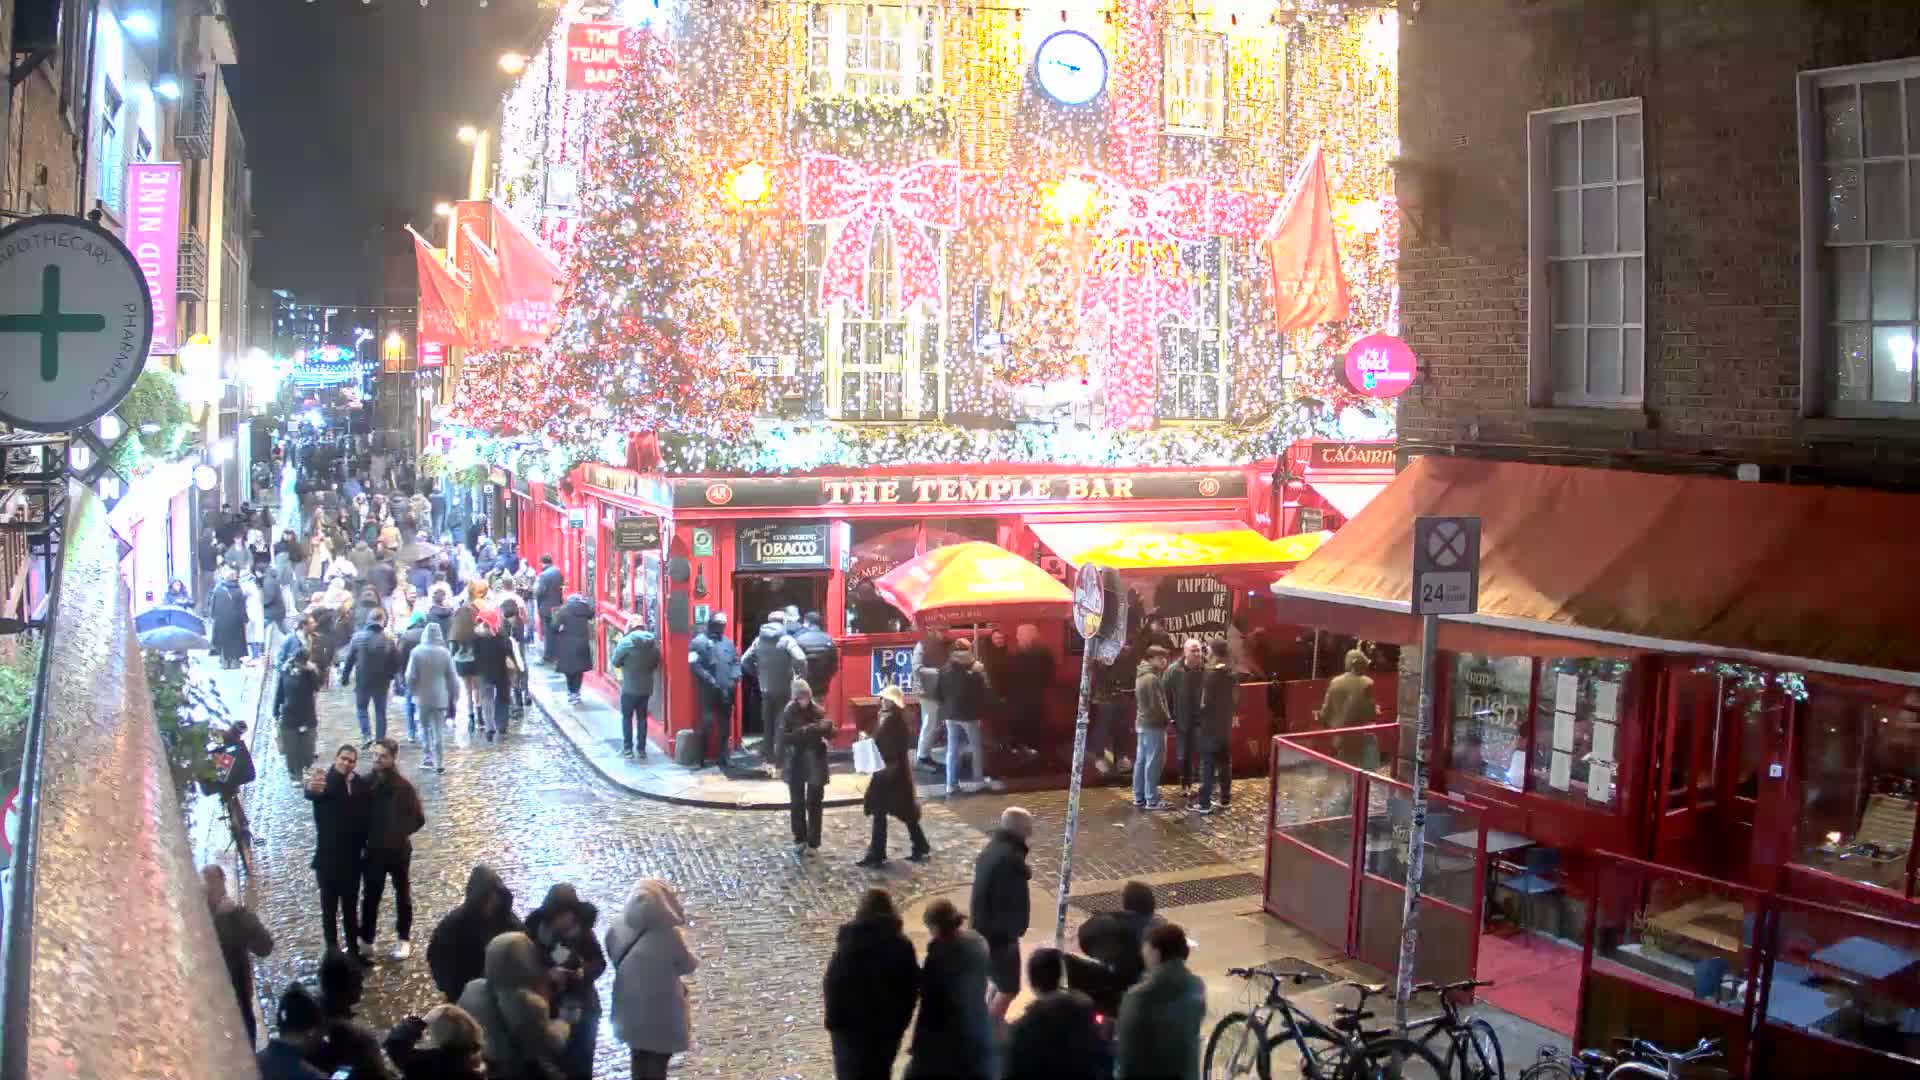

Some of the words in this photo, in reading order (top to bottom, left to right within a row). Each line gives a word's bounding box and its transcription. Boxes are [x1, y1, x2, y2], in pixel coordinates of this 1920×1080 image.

[137, 171, 170, 232] NINE
[823, 478, 900, 504] THE
[912, 476, 1051, 504] TEMPLE
[1068, 476, 1134, 499] BAR
[751, 538, 817, 561] TOBACCO
[1213, 592, 1226, 607] OF
[1424, 583, 1444, 602] 24
